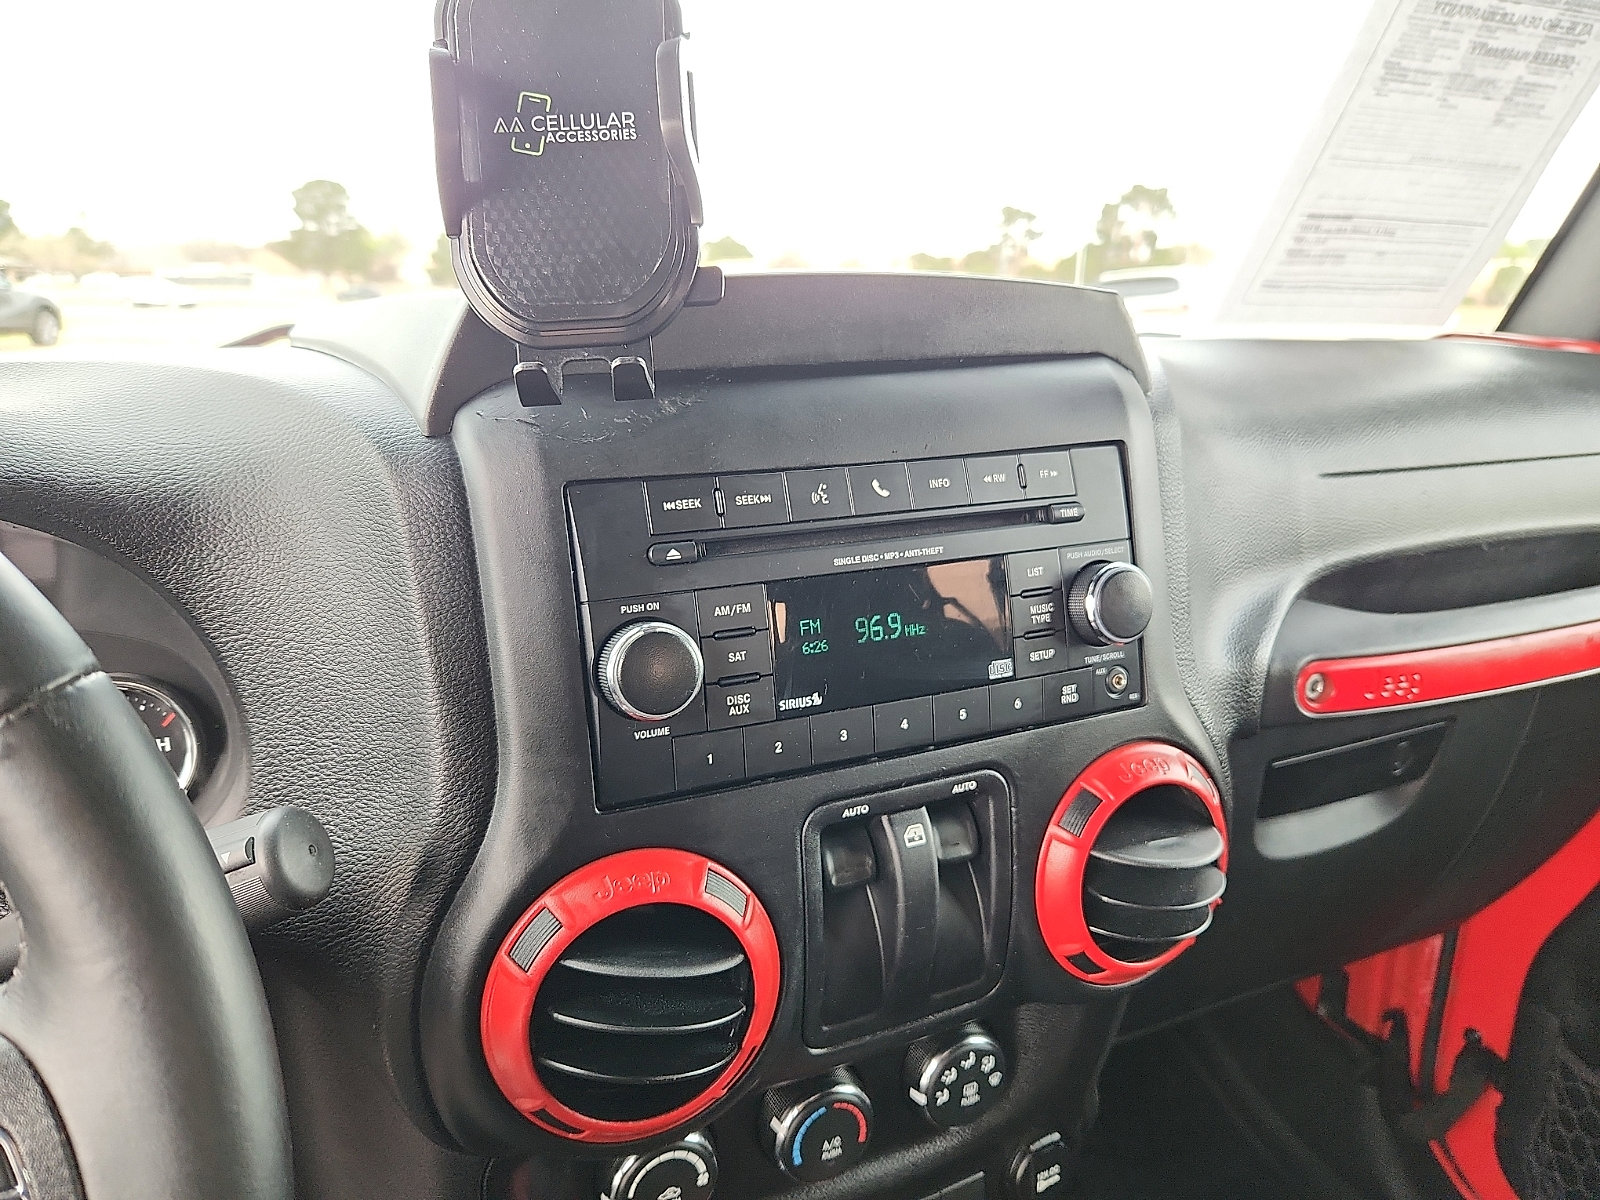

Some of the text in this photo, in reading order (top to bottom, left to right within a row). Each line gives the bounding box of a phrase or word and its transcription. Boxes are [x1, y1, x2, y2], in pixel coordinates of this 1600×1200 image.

[531, 112, 636, 132] CELLULAR
[546, 128, 637, 144] ACCESSORIES
[992, 473, 1006, 483] RW
[1039, 470, 1049, 479] FF
[929, 478, 950, 489] INFO
[675, 498, 702, 511] SEEK
[735, 494, 760, 506] SEEK
[1060, 508, 1078, 518] TIME
[833, 546, 944, 567] SINGLE DISC MP3 ANTI-THEFT
[1066, 546, 1125, 560] PUSH AUDIO/SELECT
[1027, 567, 1043, 578] LIST
[620, 601, 661, 614] PUSH ON
[714, 603, 752, 617] AM/FM
[1030, 603, 1053, 615] MUSIC
[1031, 614, 1051, 624] TYPE
[799, 619, 822, 636] FM
[854, 612, 902, 643] 96.9
[904, 624, 926, 637] MHz
[801, 640, 829, 655] 6:26
[728, 651, 747, 663] SAT
[1029, 649, 1055, 661] SETUP
[1083, 650, 1125, 664] TUNE/SCROLL
[1095, 667, 1107, 676] AUX
[1061, 684, 1078, 695] SET
[726, 693, 751, 706] DISC
[779, 696, 813, 711] SIRIUS
[1013, 697, 1023, 710] 6
[1061, 693, 1080, 705] RND
[729, 704, 750, 716] AUX
[959, 708, 968, 720] 5
[900, 718, 910, 730] 4
[634, 726, 671, 740] VOLUME
[839, 729, 848, 742] 3
[156, 736, 172, 752] H
[774, 741, 783, 754] 2
[706, 753, 714, 765] 1
[1117, 757, 1171, 783] Jeep
[951, 781, 978, 795] AUTO
[841, 805, 870, 820] AUTO
[594, 871, 671, 901] Jeep
